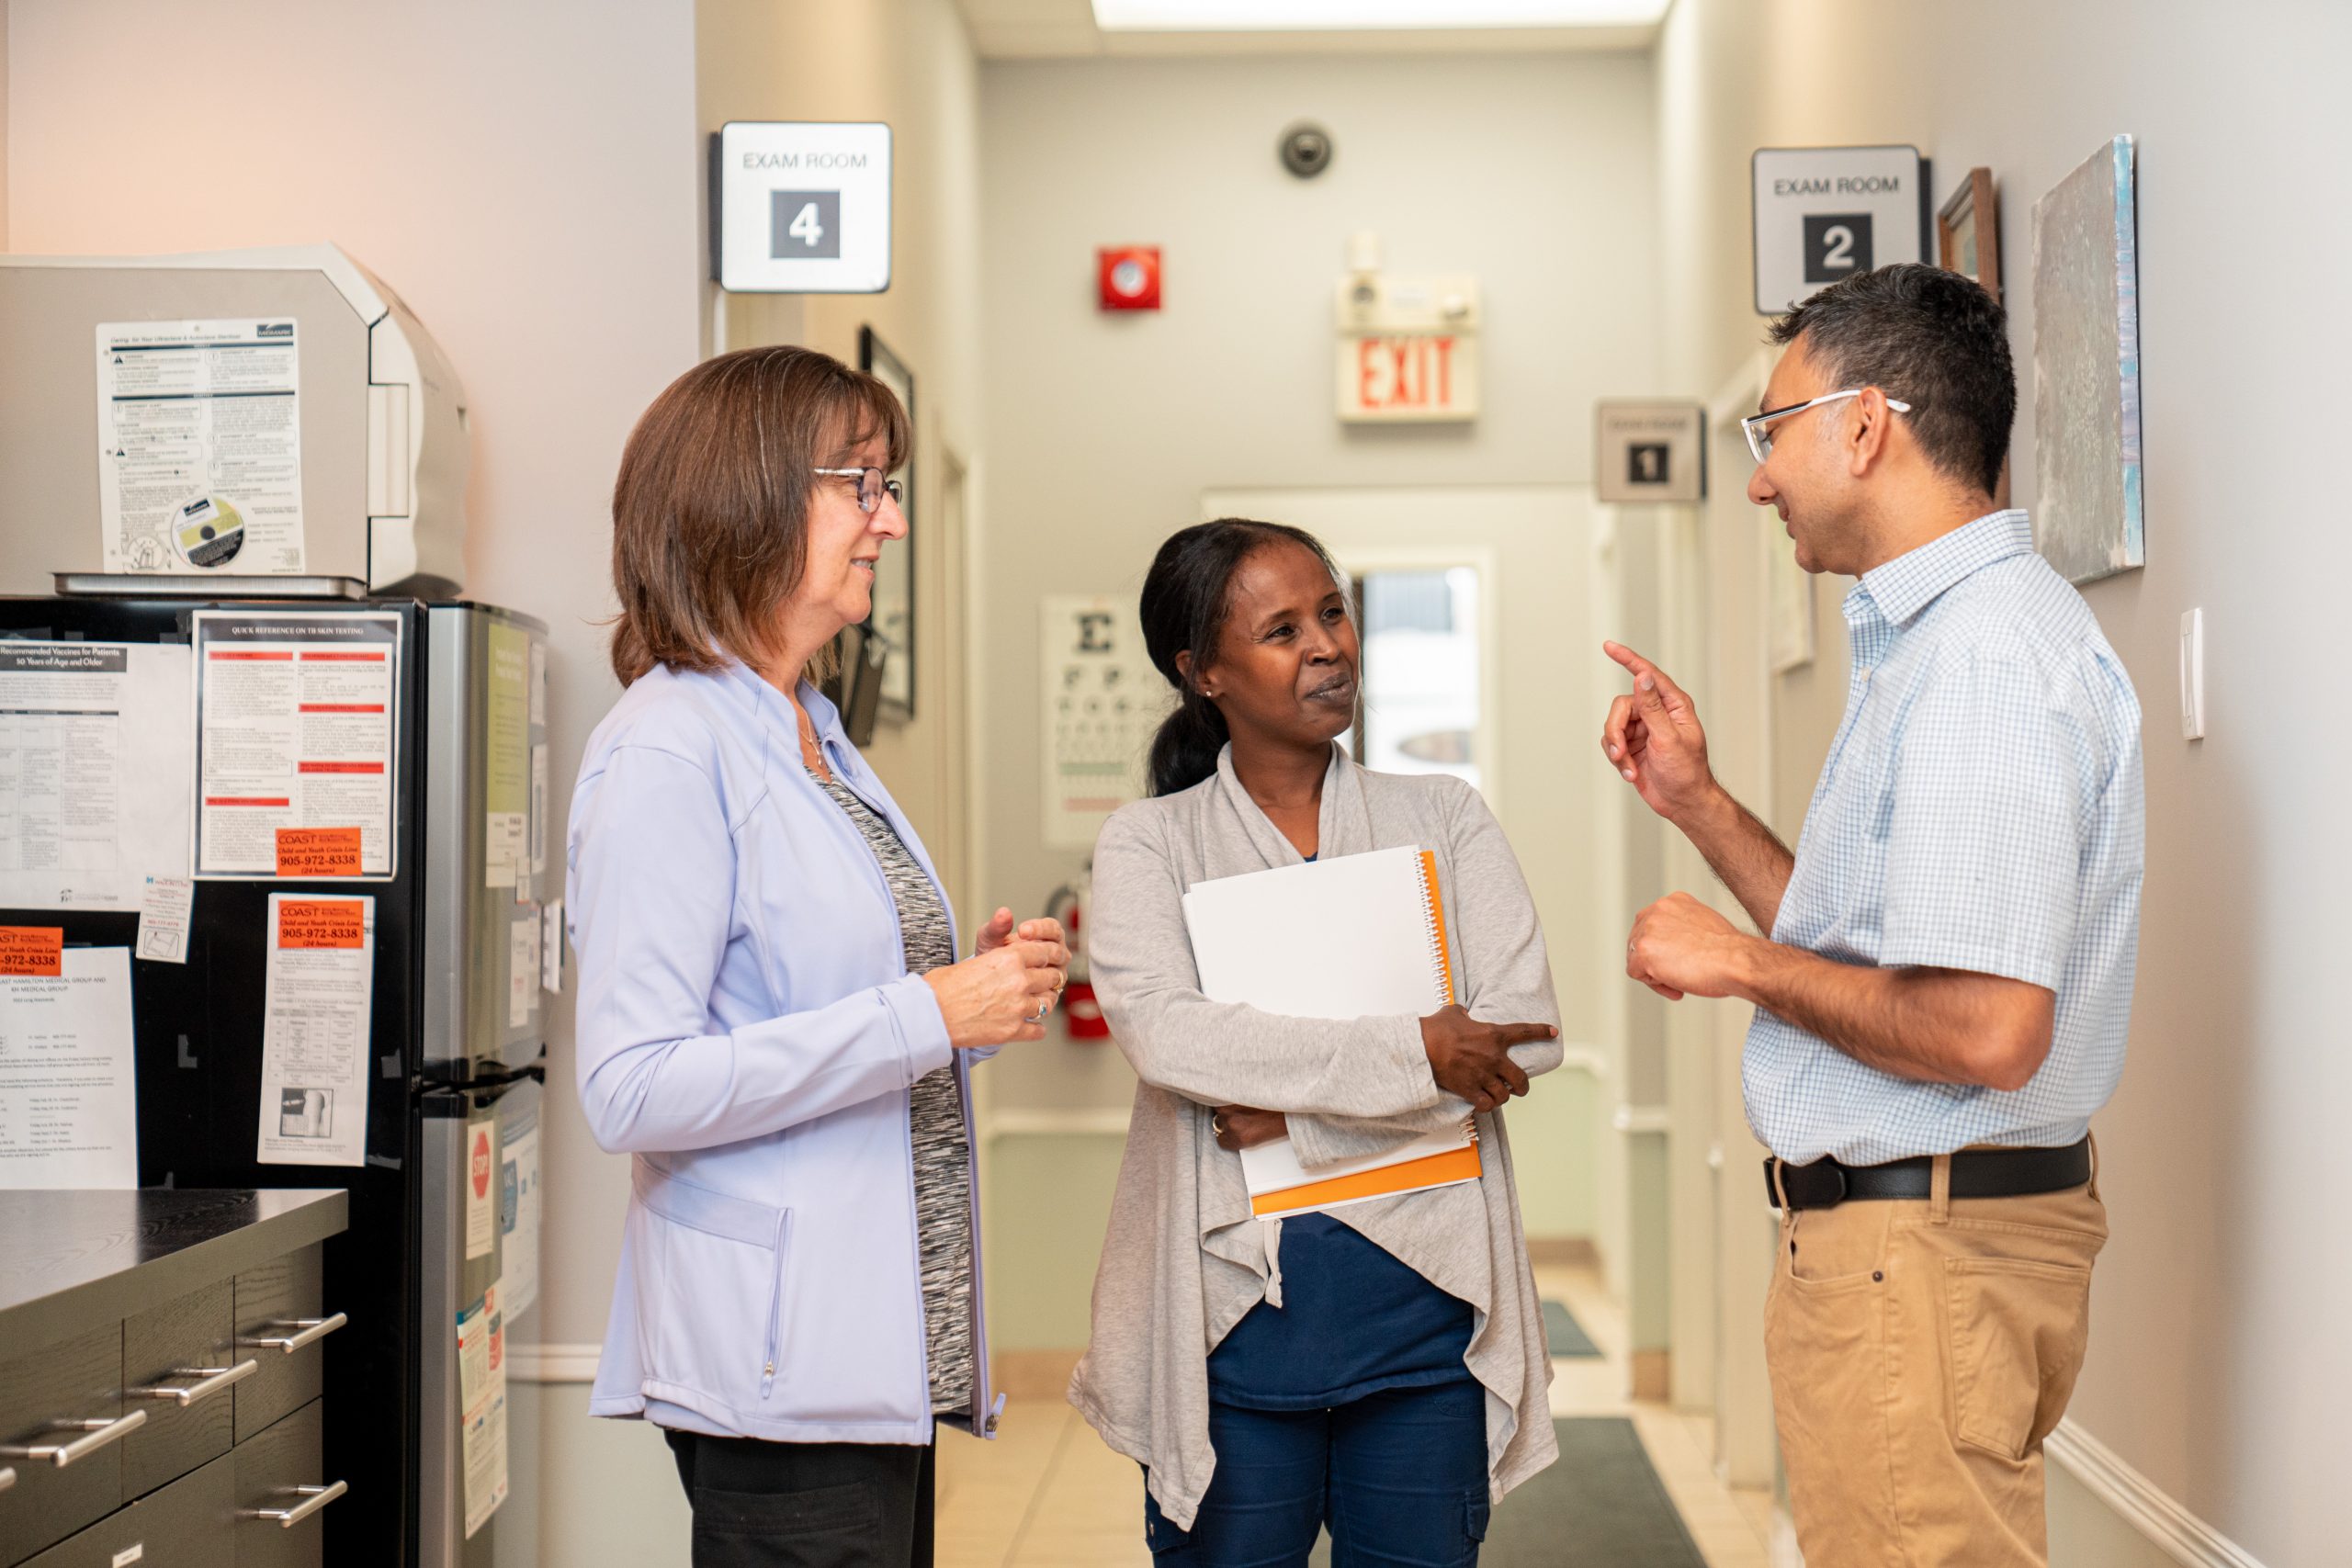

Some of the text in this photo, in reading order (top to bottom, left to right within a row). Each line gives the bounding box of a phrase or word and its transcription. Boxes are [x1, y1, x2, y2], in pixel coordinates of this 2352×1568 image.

[742, 152, 867, 169] EXAM ROOM
[1773, 176, 1899, 196] EXAM ROOM
[789, 202, 824, 247] 4
[1823, 225, 1855, 268] 2
[1358, 336, 1455, 409] EXIT
[1638, 449, 1657, 479] 1
[1074, 613, 1113, 653] E
[0, 647, 119, 656] Recommended Vaccines for Patients
[46, 657, 53, 665] of
[54, 658, 69, 668] Age
[83, 658, 103, 666] Older
[278, 834, 317, 844] COAST
[280, 854, 356, 866] 905-972-8338
[280, 908, 319, 917] COAST
[282, 928, 357, 939] 905-972-8338
[473, 1154, 489, 1177] STOP!
